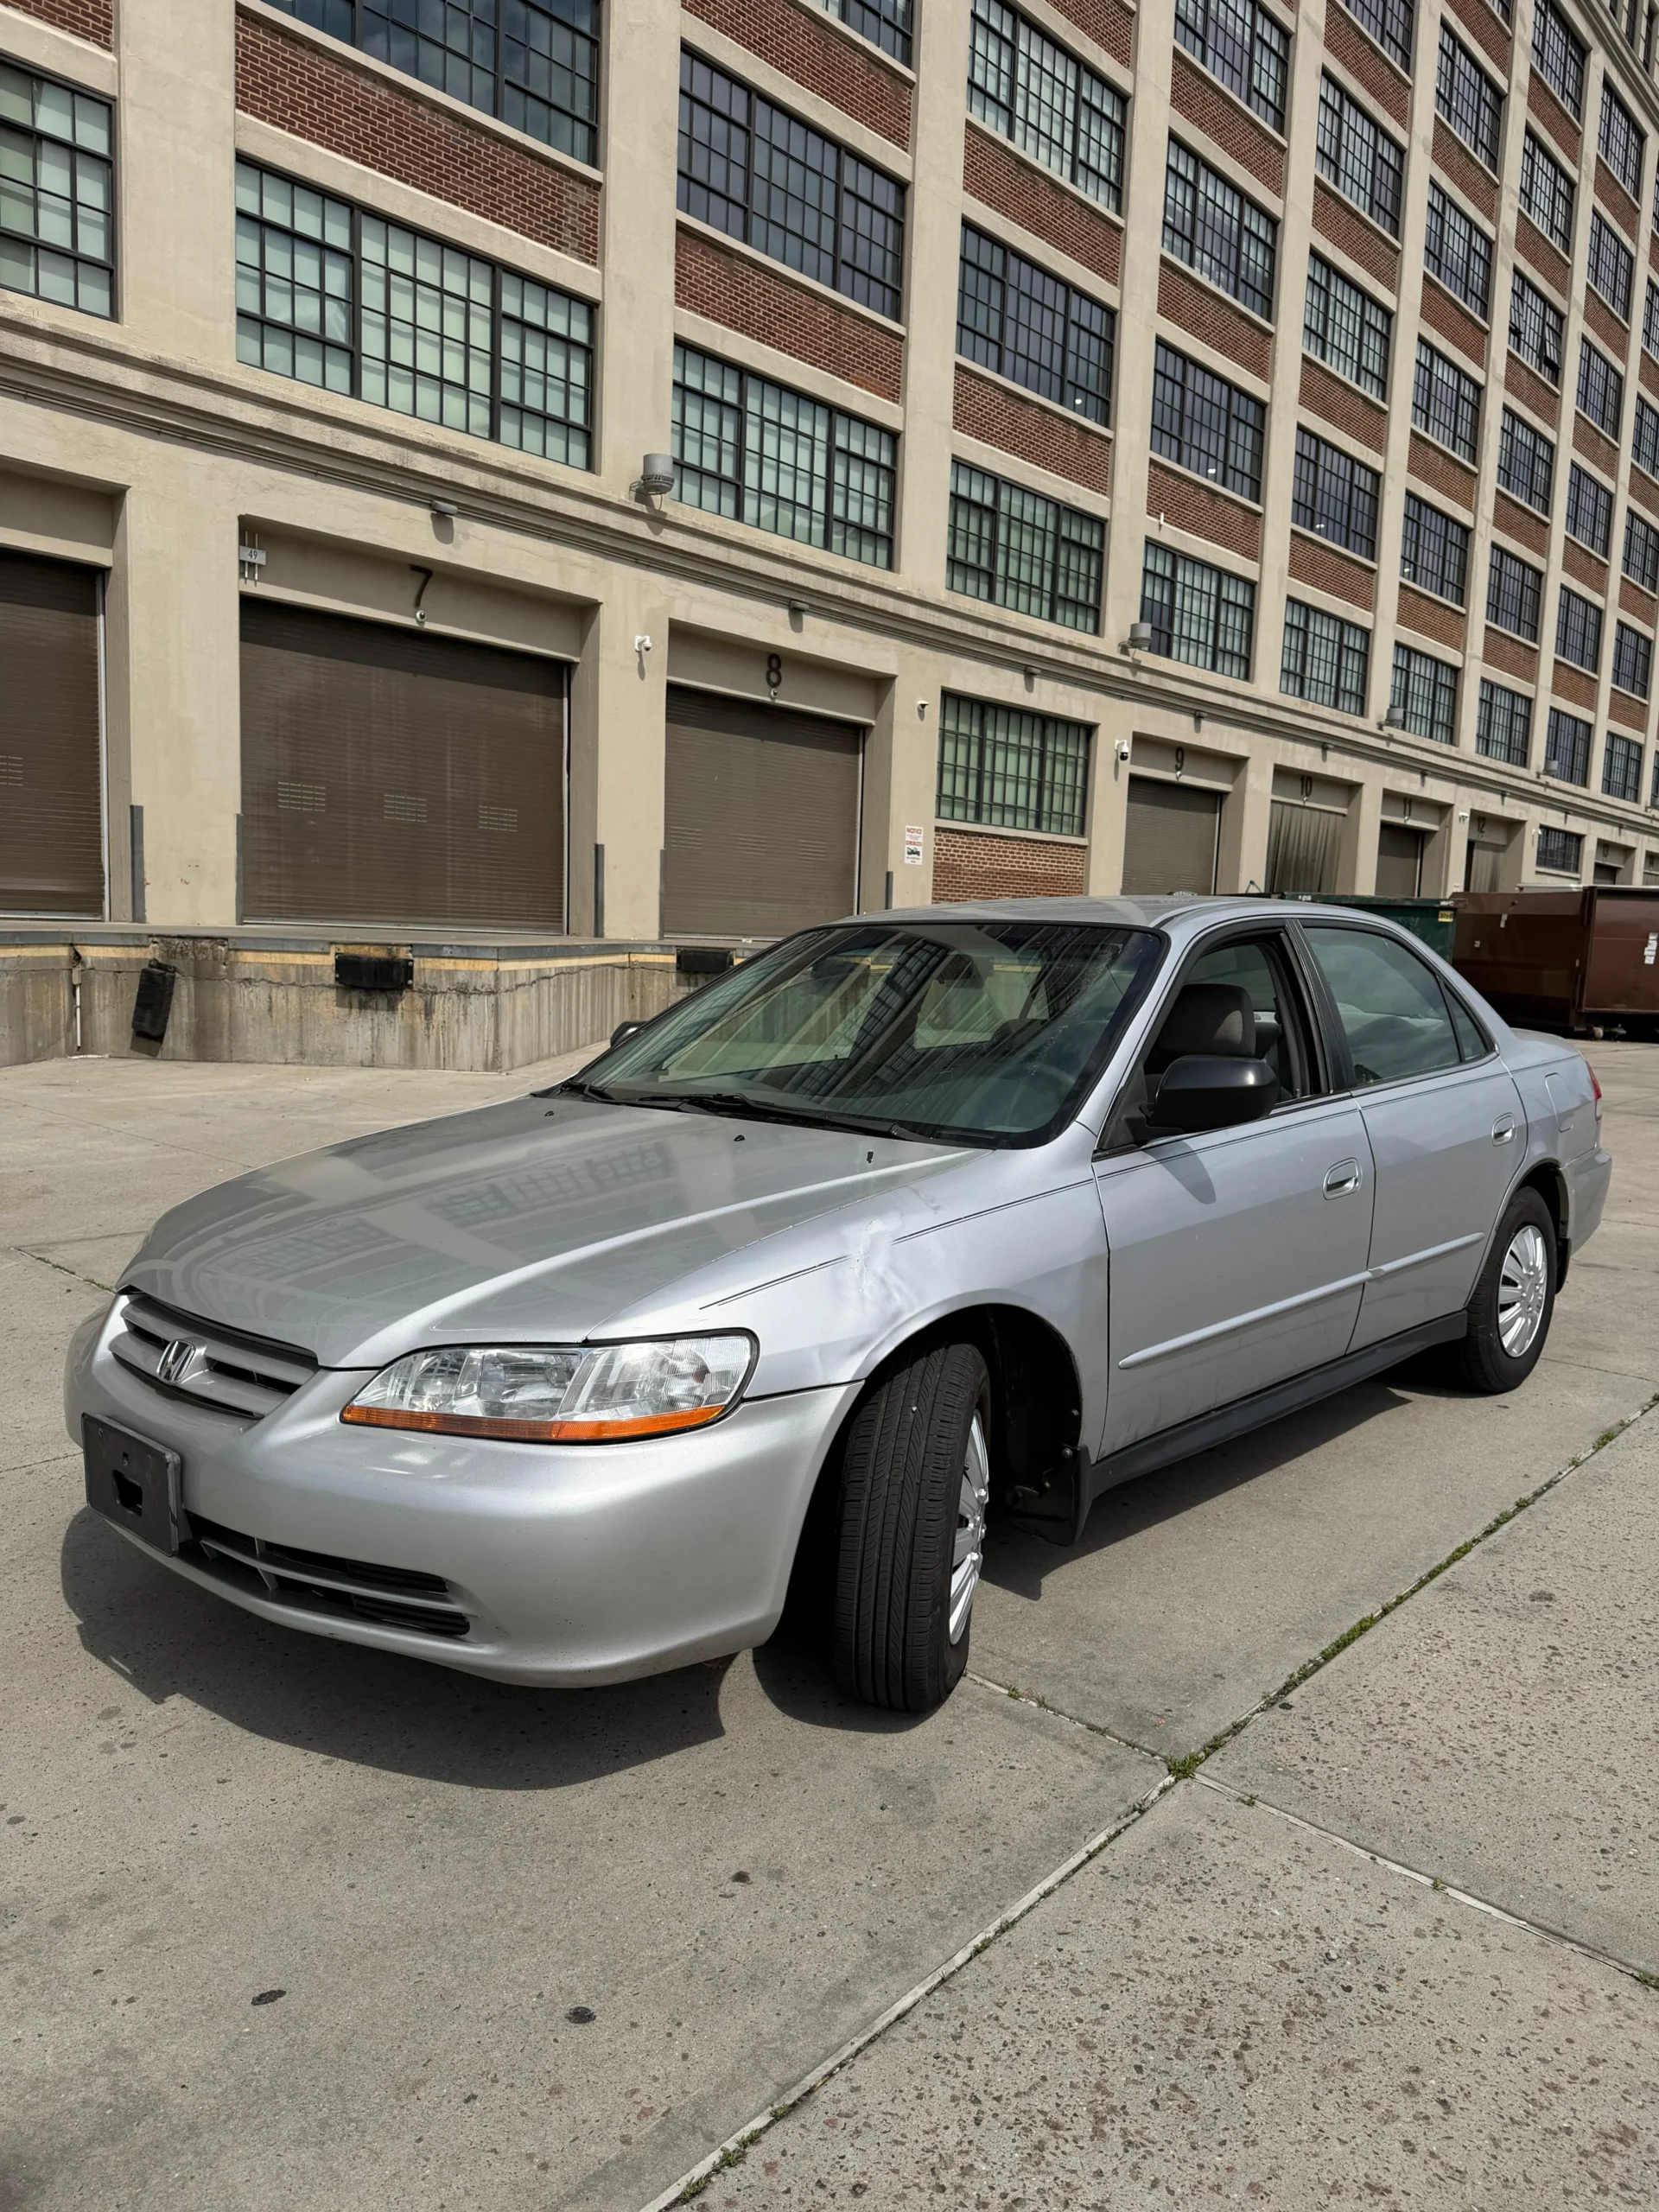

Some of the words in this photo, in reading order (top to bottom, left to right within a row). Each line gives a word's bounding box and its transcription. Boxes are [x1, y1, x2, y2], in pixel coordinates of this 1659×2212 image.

[248, 550, 257, 560] 49
[410, 564, 434, 608] 7
[766, 653, 782, 688] 8
[1175, 747, 1185, 772] 9
[1300, 775, 1313, 797] 10
